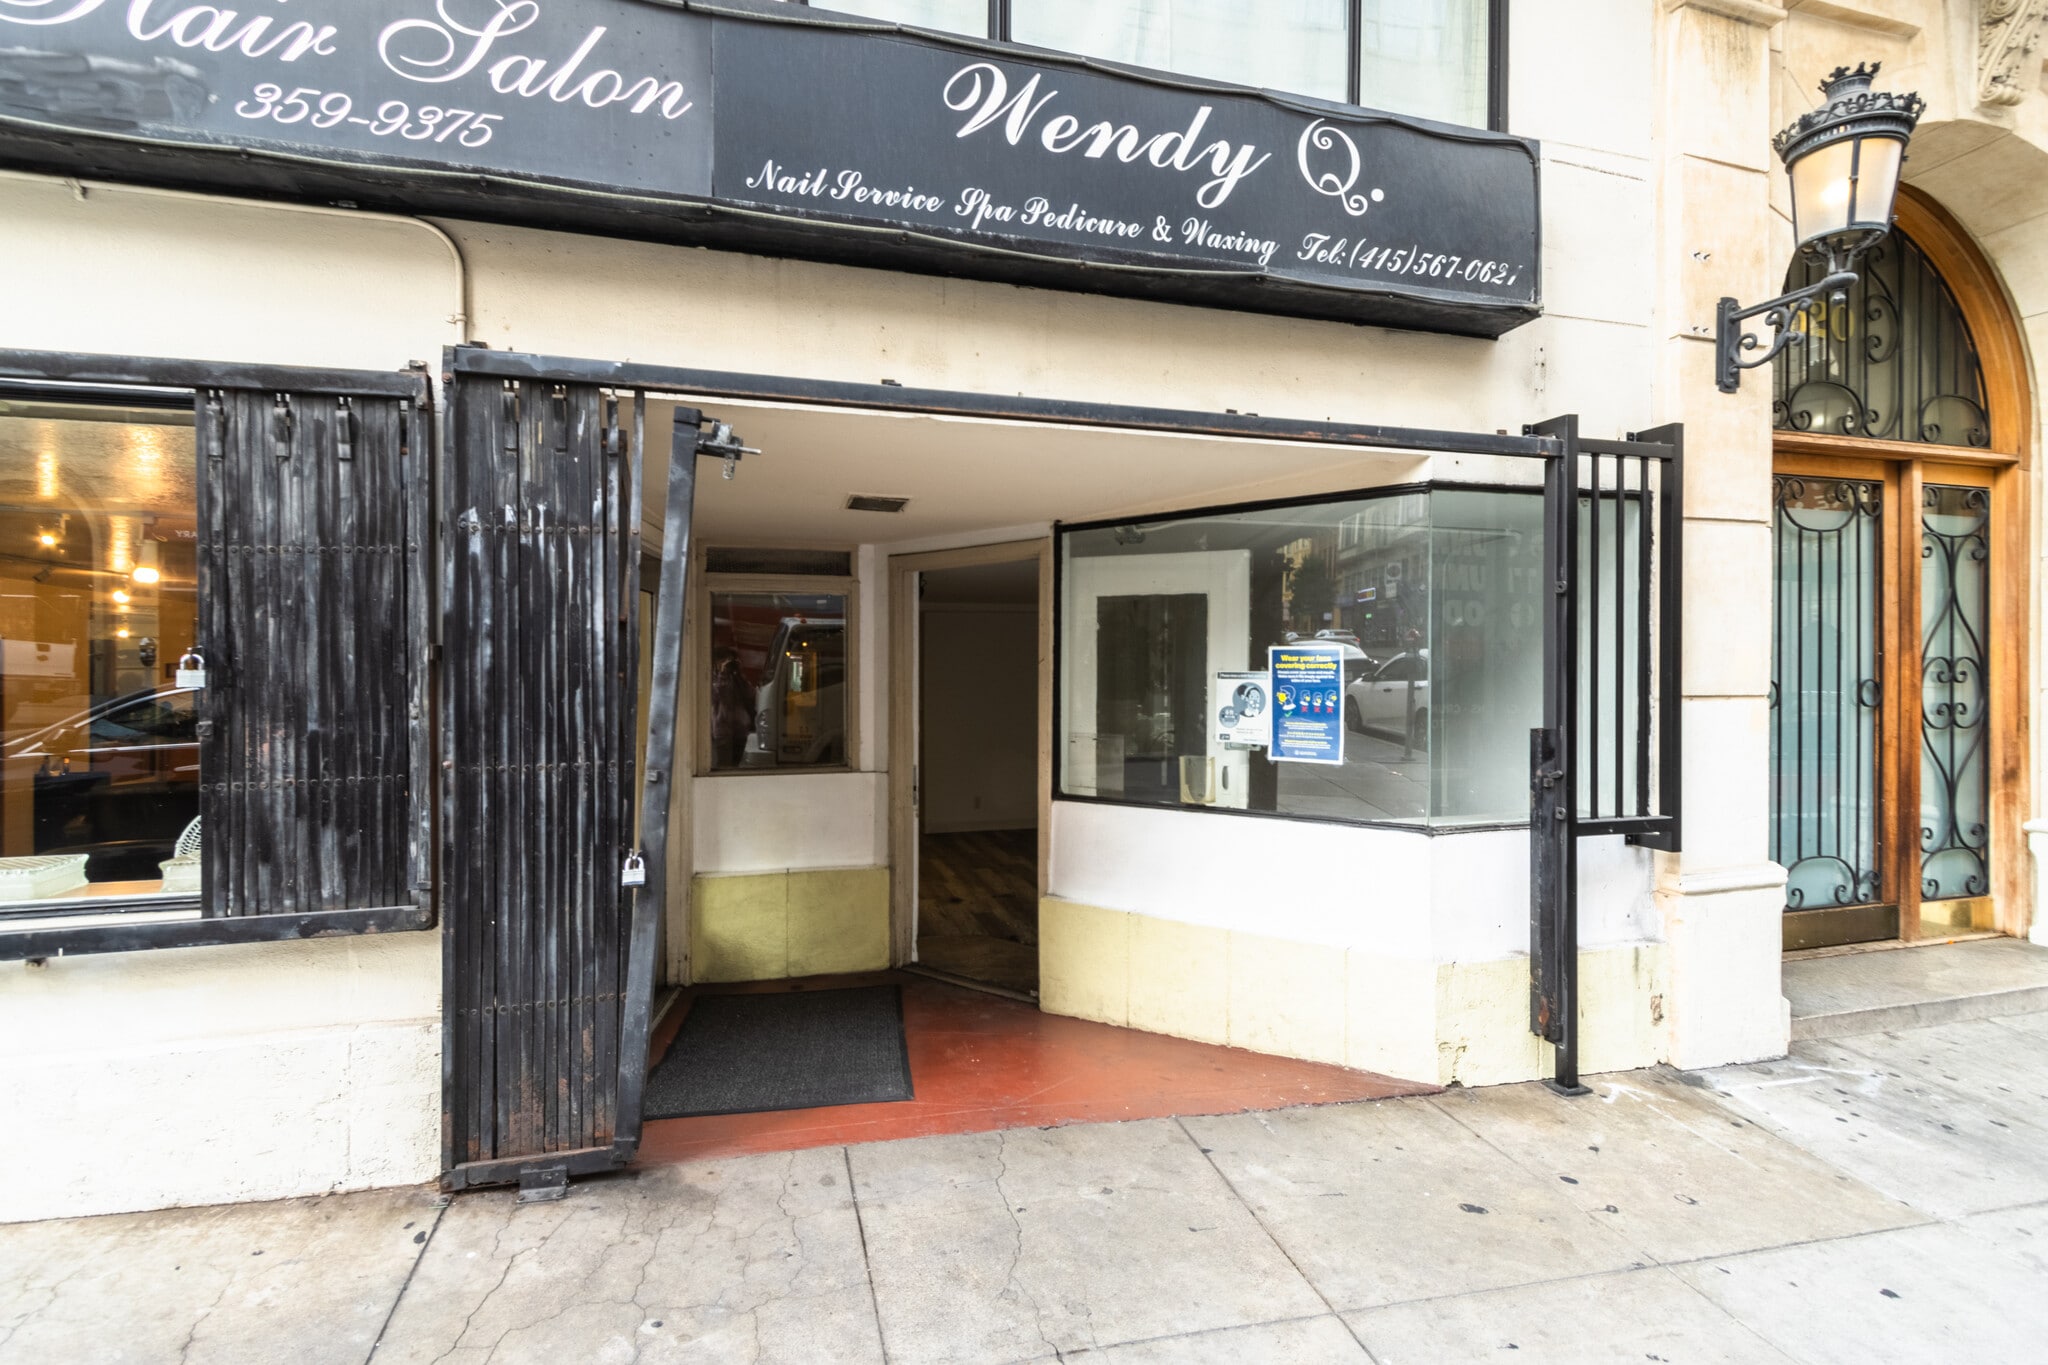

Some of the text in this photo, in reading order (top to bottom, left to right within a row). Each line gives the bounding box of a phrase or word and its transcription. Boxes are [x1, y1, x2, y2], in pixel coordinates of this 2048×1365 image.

[234, 82, 504, 148] 359-9375
[372, 0, 694, 120] Salon
[942, 62, 1386, 218] Wendy Q.
[745, 159, 828, 198] Nail
[830, 169, 946, 213] Service
[954, 187, 1019, 230] Spa
[1020, 196, 1145, 238] Pedicure
[1151, 215, 1173, 243] &
[1181, 216, 1281, 267] Waxing
